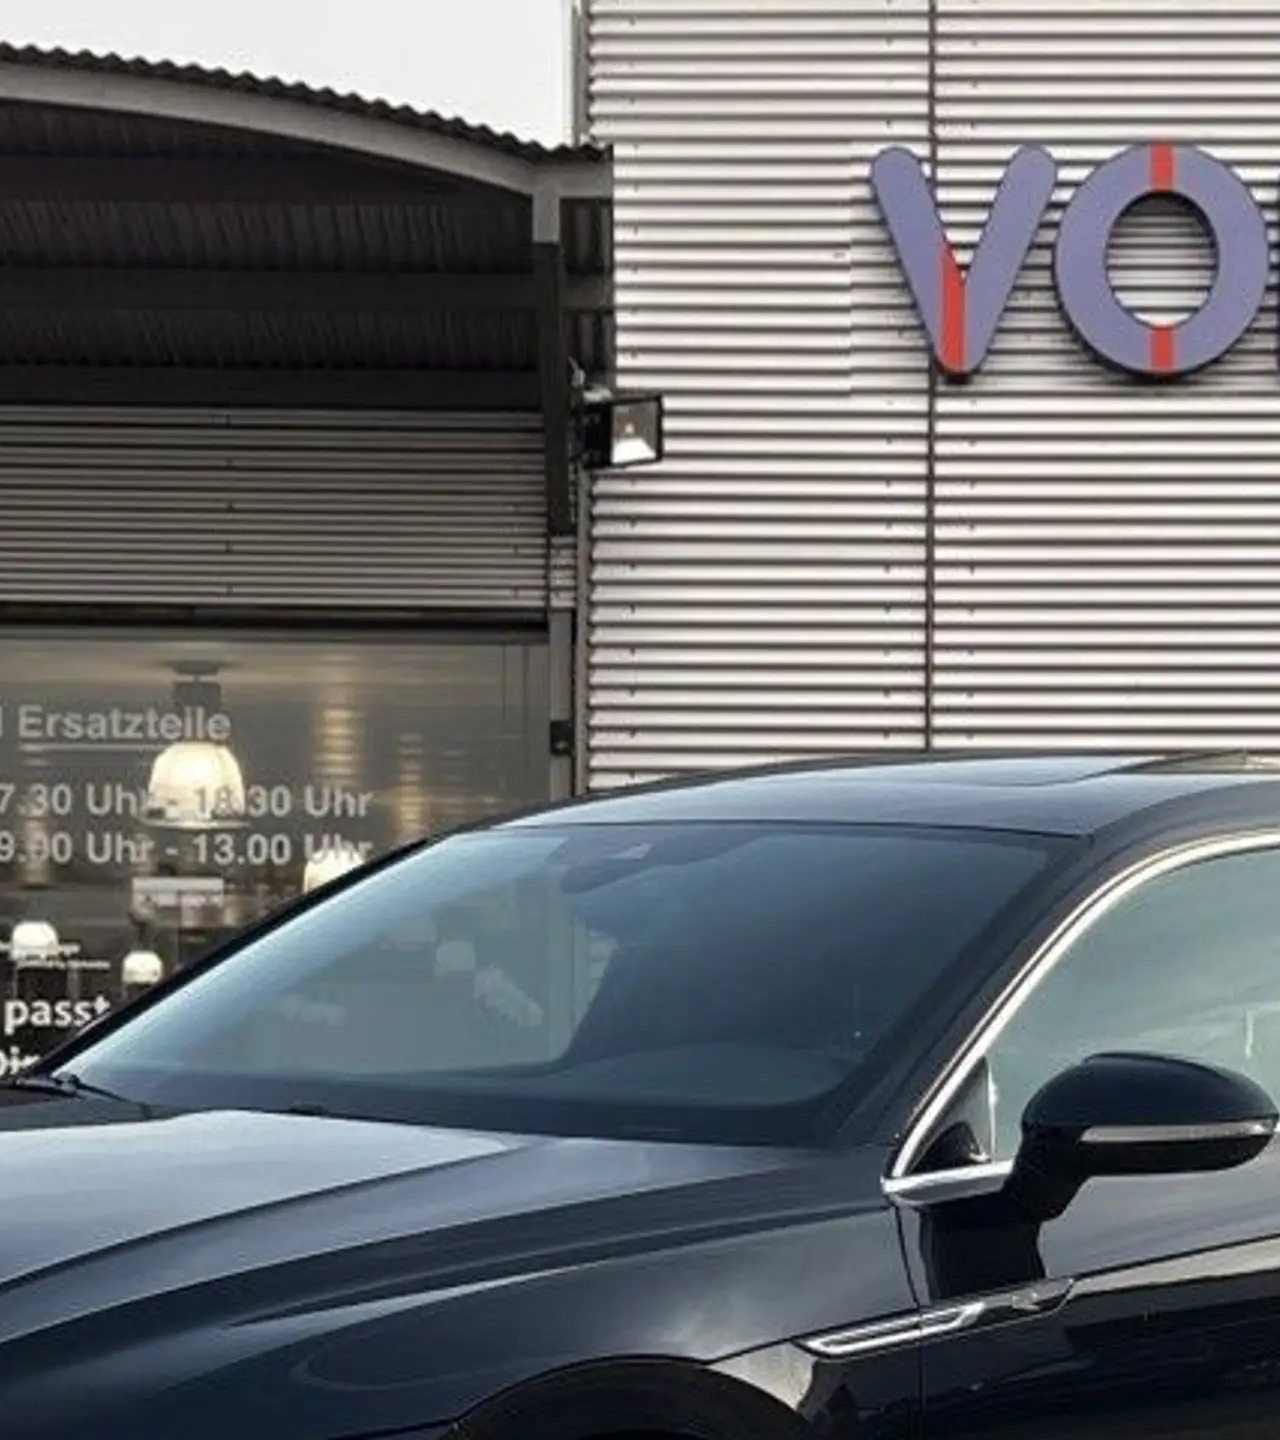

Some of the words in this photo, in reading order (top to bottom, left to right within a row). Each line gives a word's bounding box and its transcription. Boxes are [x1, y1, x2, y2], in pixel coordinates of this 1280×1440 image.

[19, 705, 231, 740] Ersatzteile
[305, 785, 374, 818] Uhr
[86, 831, 154, 864] Uhr
[193, 832, 291, 866] 13.00
[305, 833, 374, 865] Uhr
